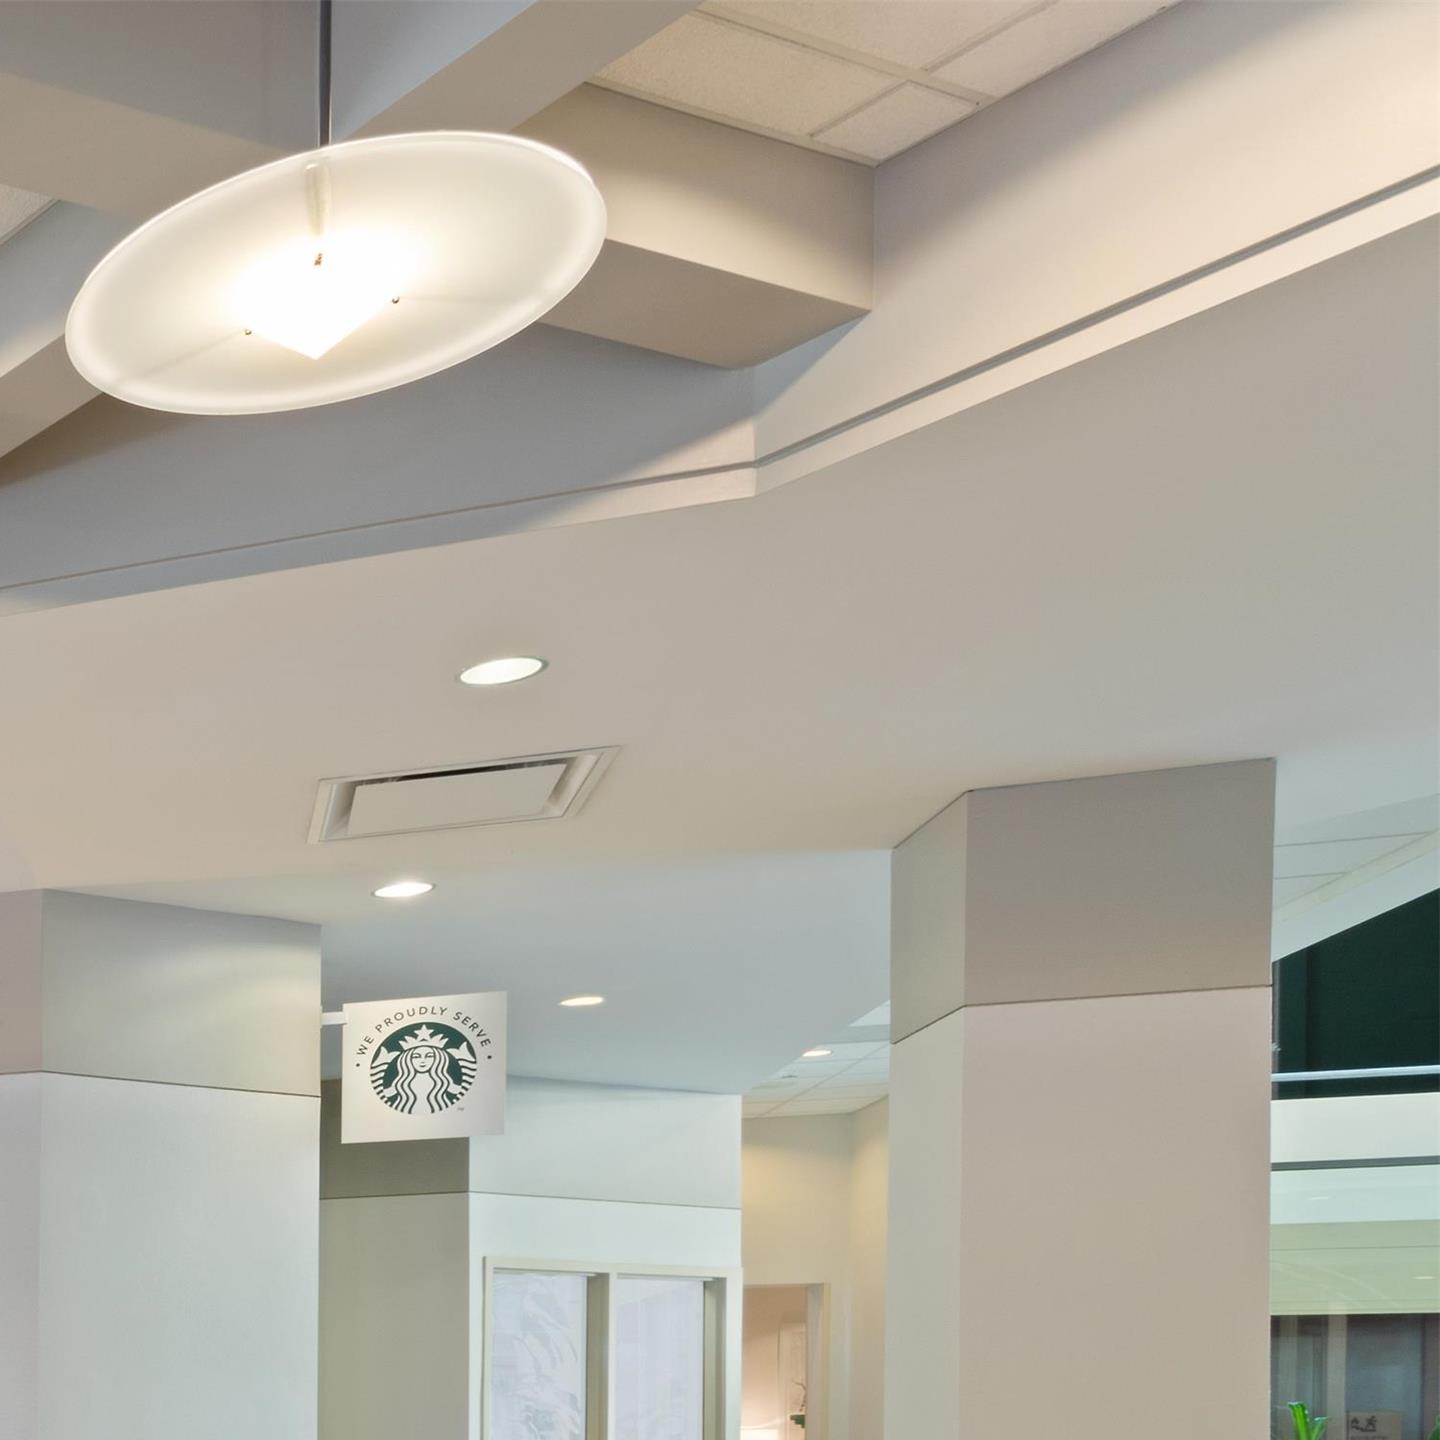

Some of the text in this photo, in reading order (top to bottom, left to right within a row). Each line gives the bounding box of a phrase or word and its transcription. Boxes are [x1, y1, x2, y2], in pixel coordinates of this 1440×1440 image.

[356, 1006, 491, 1056] WE PROUDLY SERVE
